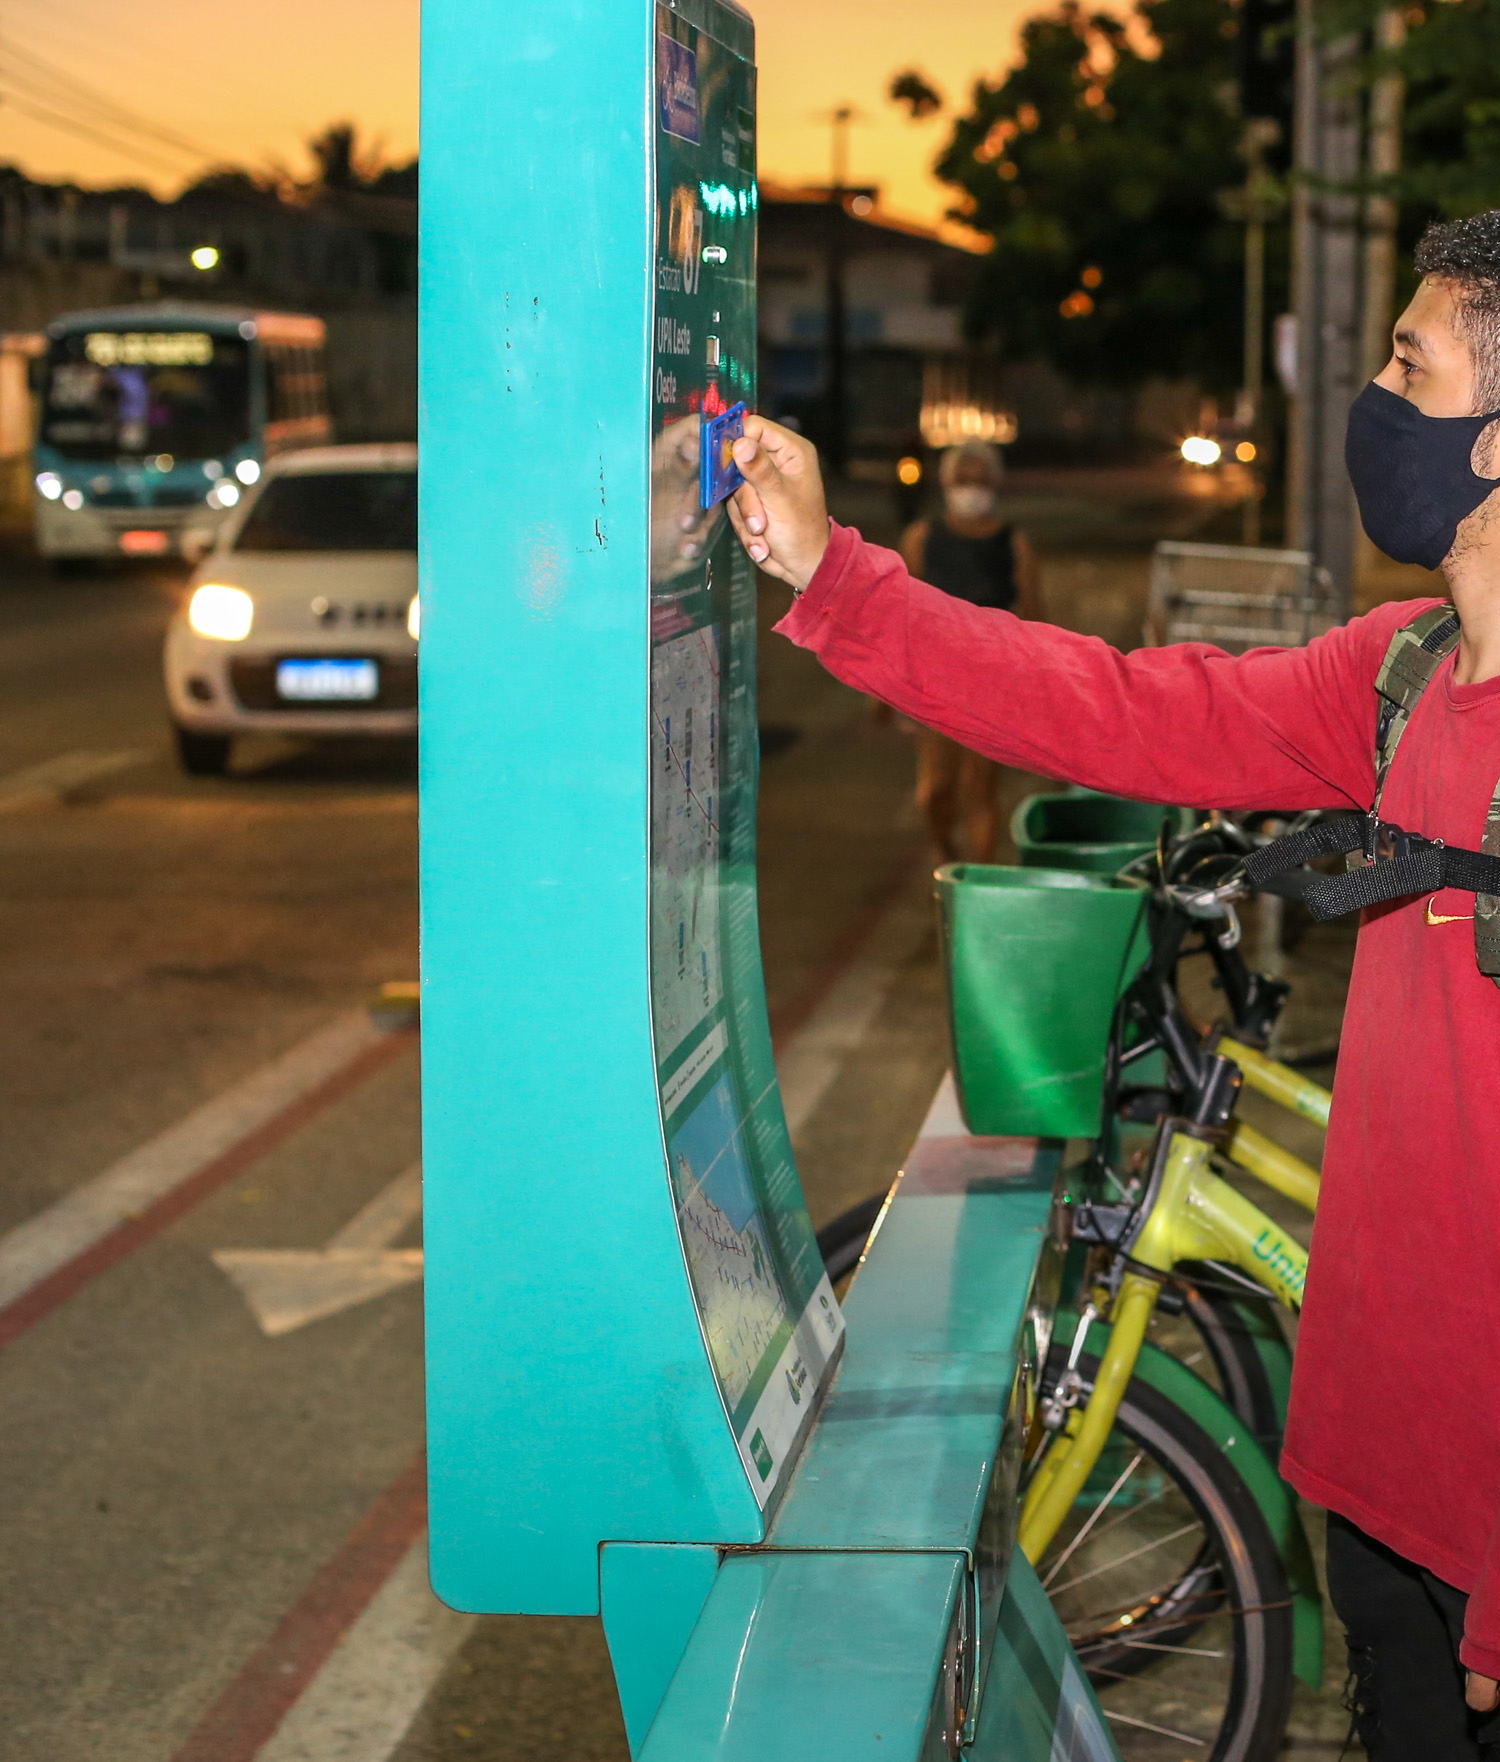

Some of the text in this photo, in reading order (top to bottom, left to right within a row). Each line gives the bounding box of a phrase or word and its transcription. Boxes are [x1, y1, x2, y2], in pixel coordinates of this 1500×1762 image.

[684, 206, 703, 294] 87
[657, 317, 691, 355] UPA Leste
[656, 366, 677, 403] Oeste
